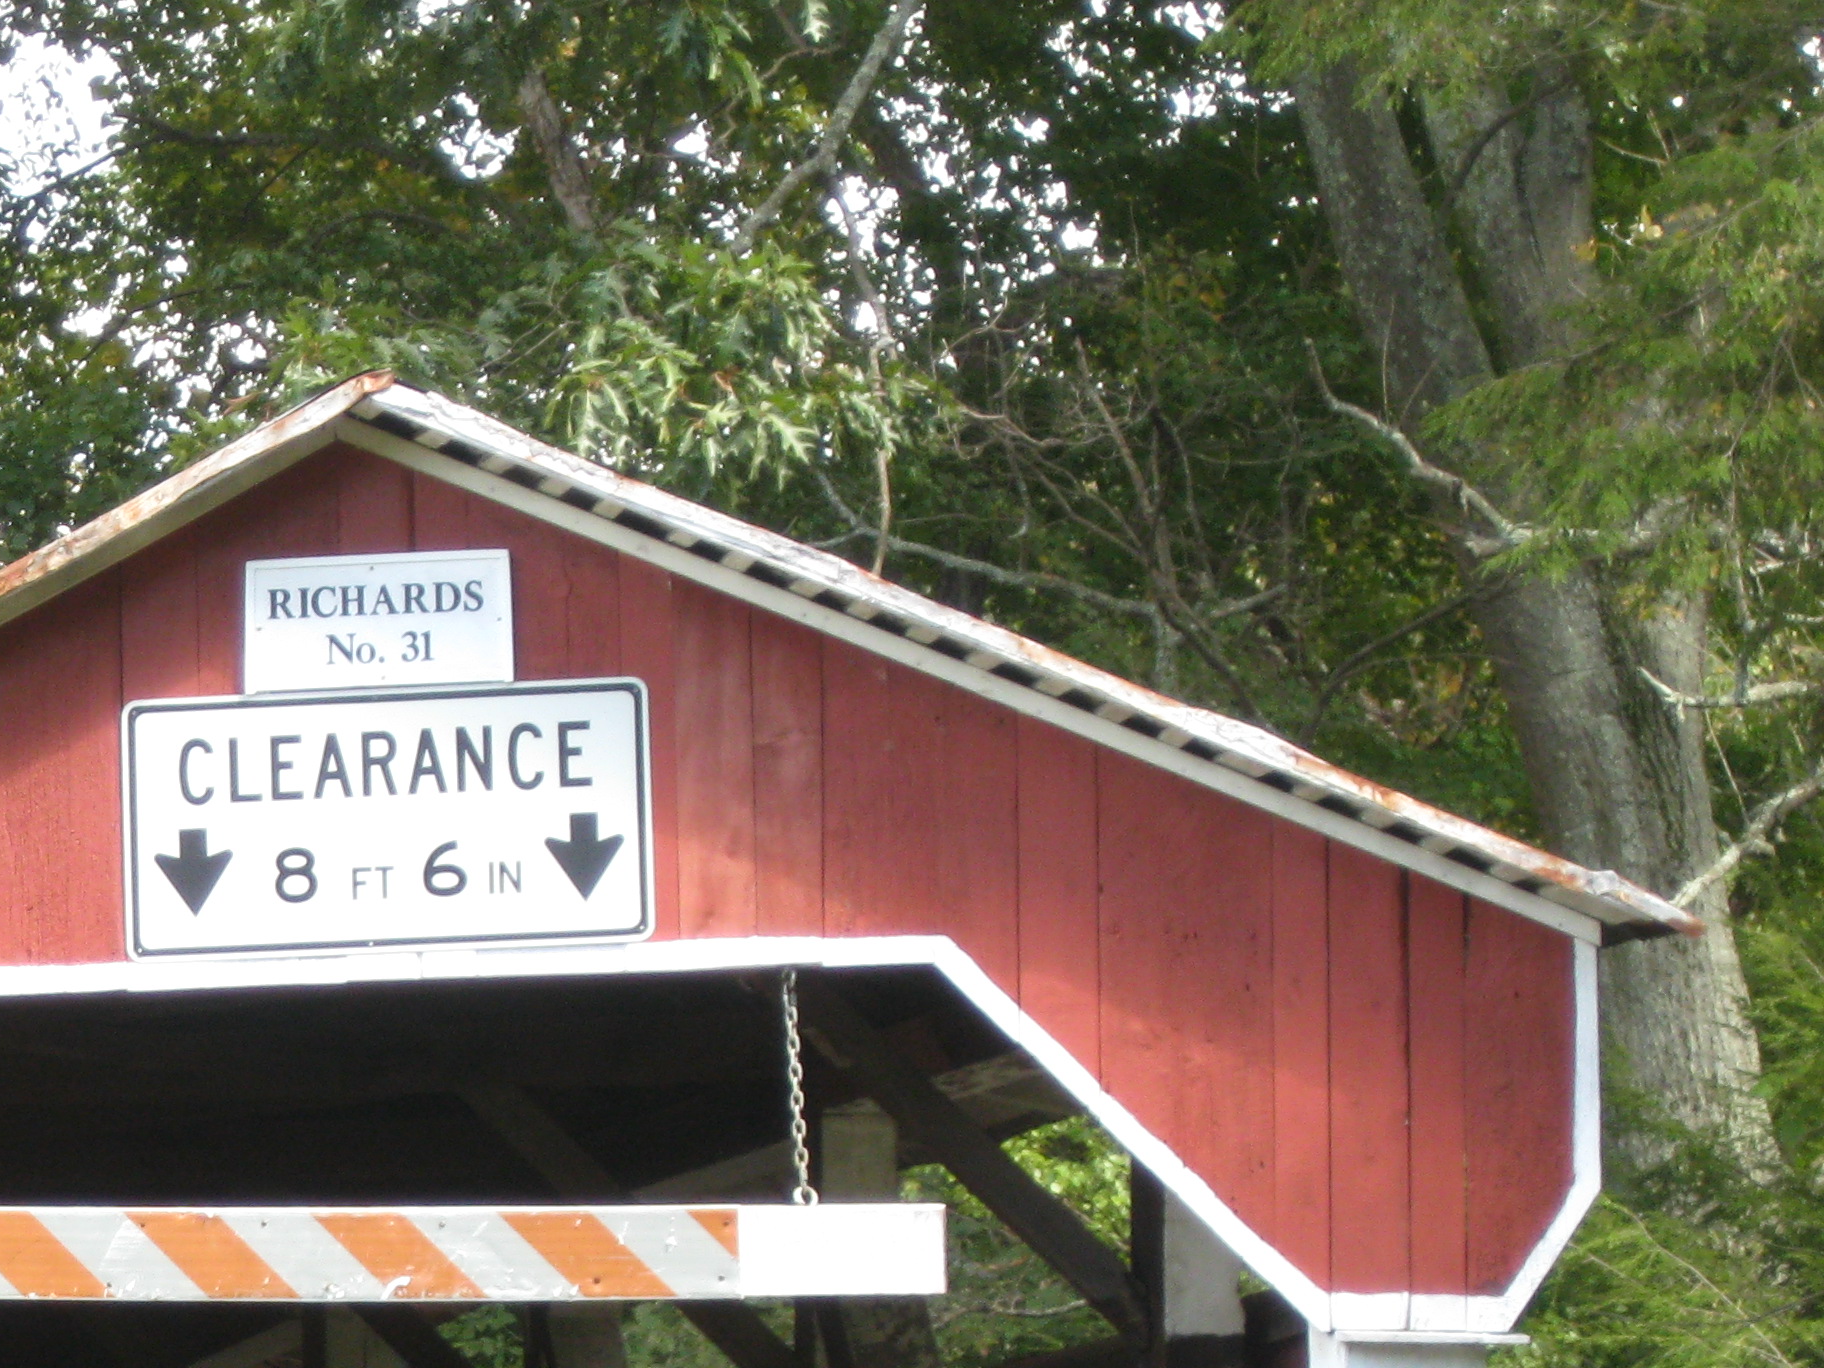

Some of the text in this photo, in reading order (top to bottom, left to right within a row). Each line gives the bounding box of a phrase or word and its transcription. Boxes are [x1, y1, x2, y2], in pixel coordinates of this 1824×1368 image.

[267, 580, 484, 621] RICHARDS
[326, 630, 435, 665] No. 31
[179, 720, 593, 805] CLEARANCE
[276, 841, 522, 903] 8 FT 6 IN
